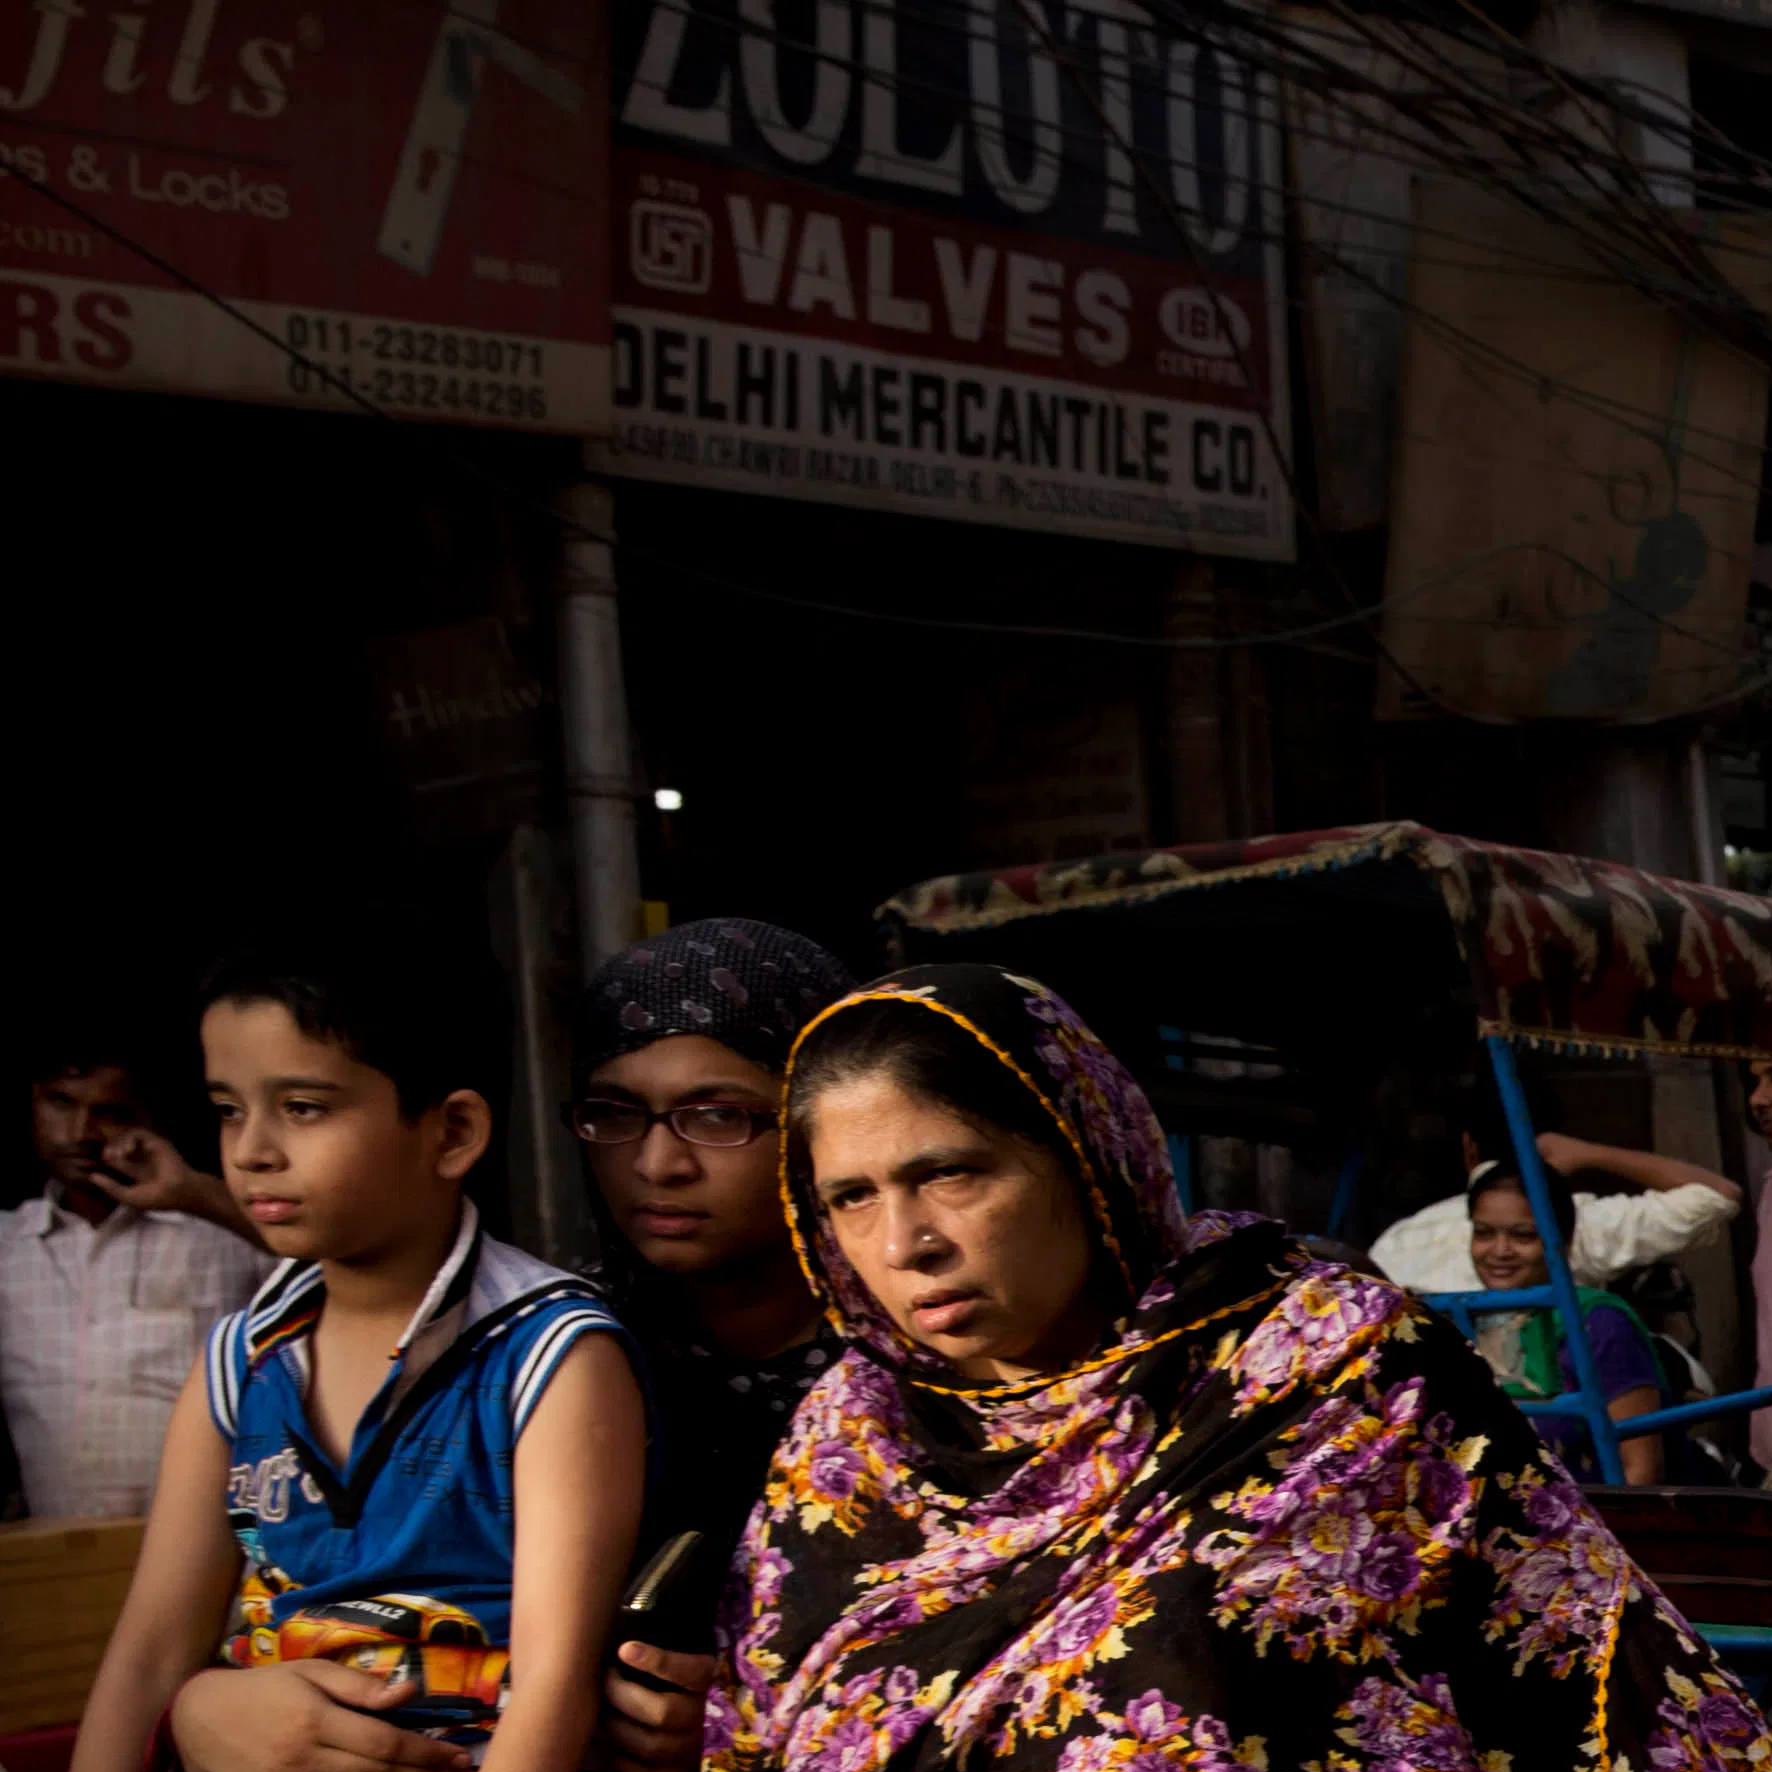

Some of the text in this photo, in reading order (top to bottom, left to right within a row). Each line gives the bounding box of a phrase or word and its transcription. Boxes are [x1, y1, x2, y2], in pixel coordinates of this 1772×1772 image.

[67, 144, 111, 193] &
[128, 151, 290, 220] Locks
[727, 193, 1132, 369] VALVES
[612, 321, 1268, 502] DELHI MERCANTILE CO.
